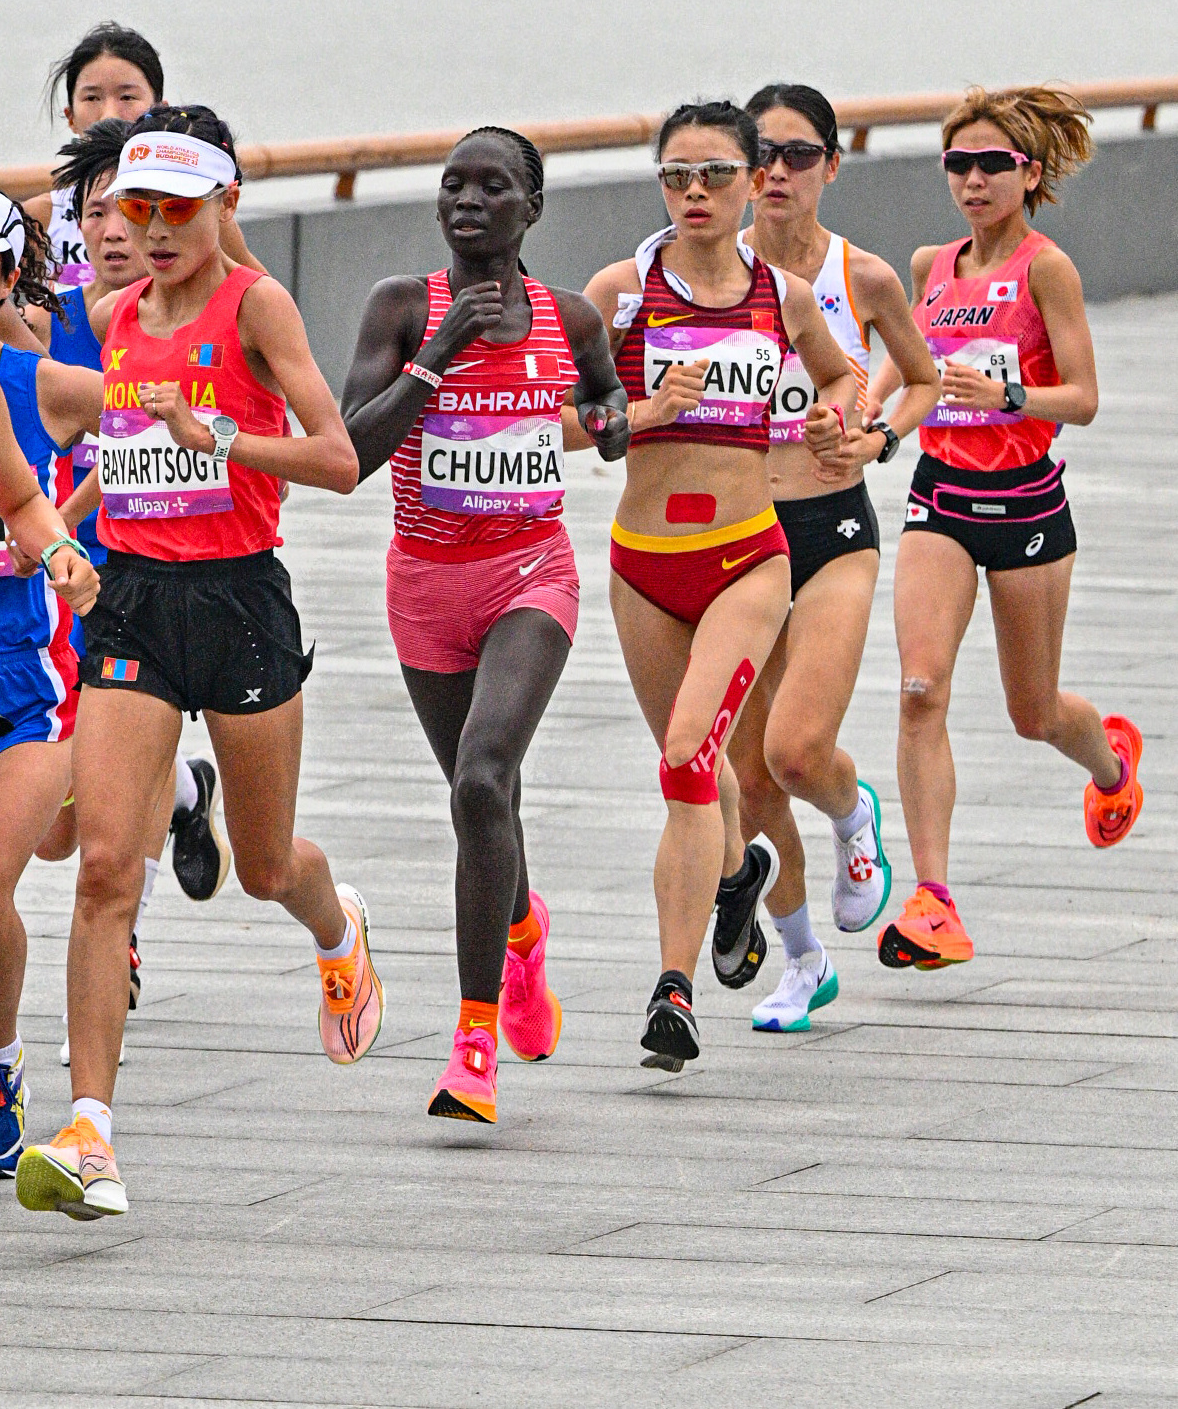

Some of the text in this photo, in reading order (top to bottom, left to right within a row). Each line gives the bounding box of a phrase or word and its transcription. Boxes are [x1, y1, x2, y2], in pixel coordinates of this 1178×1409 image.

[156, 153, 190, 163] BUDAPEST
[930, 306, 996, 328] JAPAN
[755, 348, 770, 361] 55
[990, 354, 1006, 366] 63
[652, 359, 775, 396] ZANG
[103, 380, 217, 411] MONIA
[438, 390, 557, 411] BAHRAIN
[937, 409, 973, 424] Alipay
[537, 434, 551, 447] 51
[428, 448, 562, 485] CHUMBA
[128, 497, 169, 515] Alipay
[462, 495, 511, 511] Alipay
